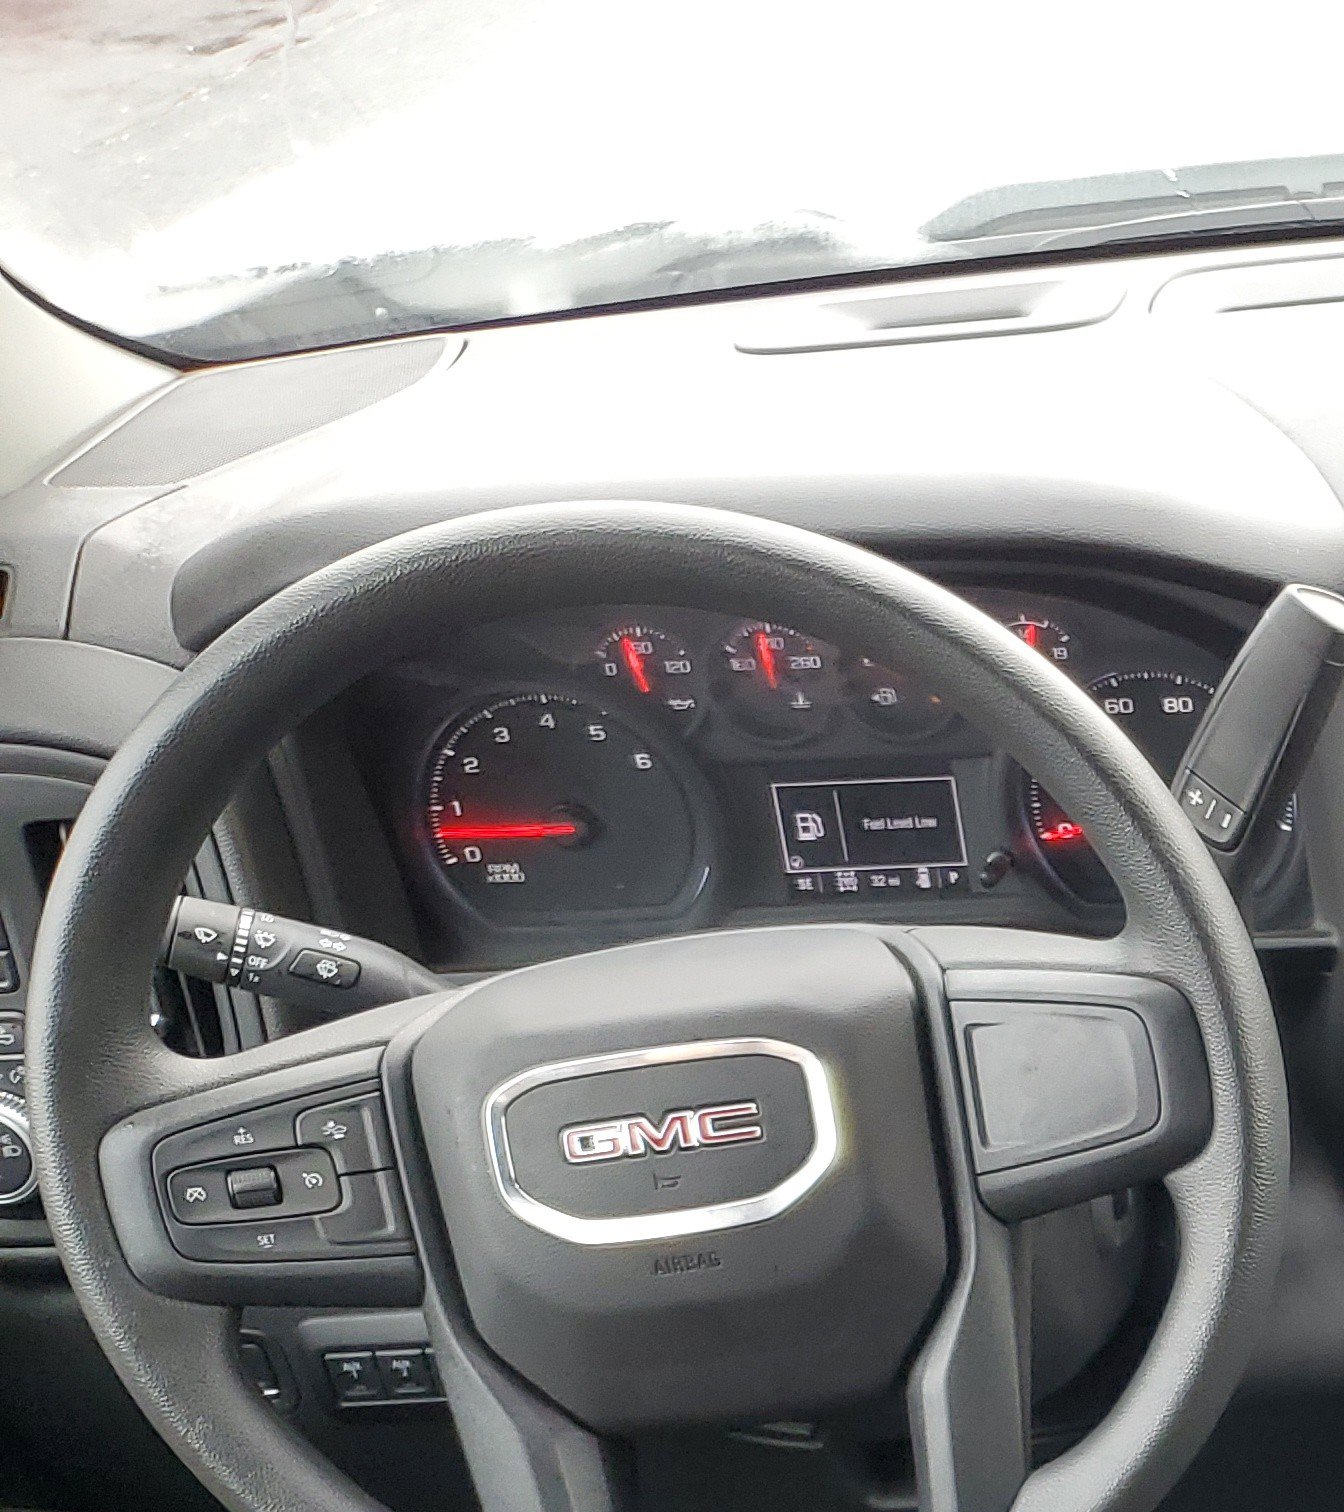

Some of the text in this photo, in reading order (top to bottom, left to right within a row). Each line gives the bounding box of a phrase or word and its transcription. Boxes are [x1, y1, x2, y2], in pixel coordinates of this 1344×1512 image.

[604, 663, 618, 676] 0
[664, 660, 691, 674] 120
[790, 655, 822, 670] 260
[1104, 698, 1134, 714] 60
[1161, 697, 1194, 714] 80
[538, 713, 556, 729] 4
[493, 727, 510, 743] 3
[588, 725, 606, 741] 5
[463, 757, 480, 774] 2
[634, 753, 652, 770] 6
[452, 800, 462, 816] 1
[464, 846, 482, 863] 0
[248, 955, 269, 968] OFF
[563, 1102, 761, 1163] GMC
[257, 1234, 274, 1246] SET
[652, 1253, 722, 1276] AIRBAG
